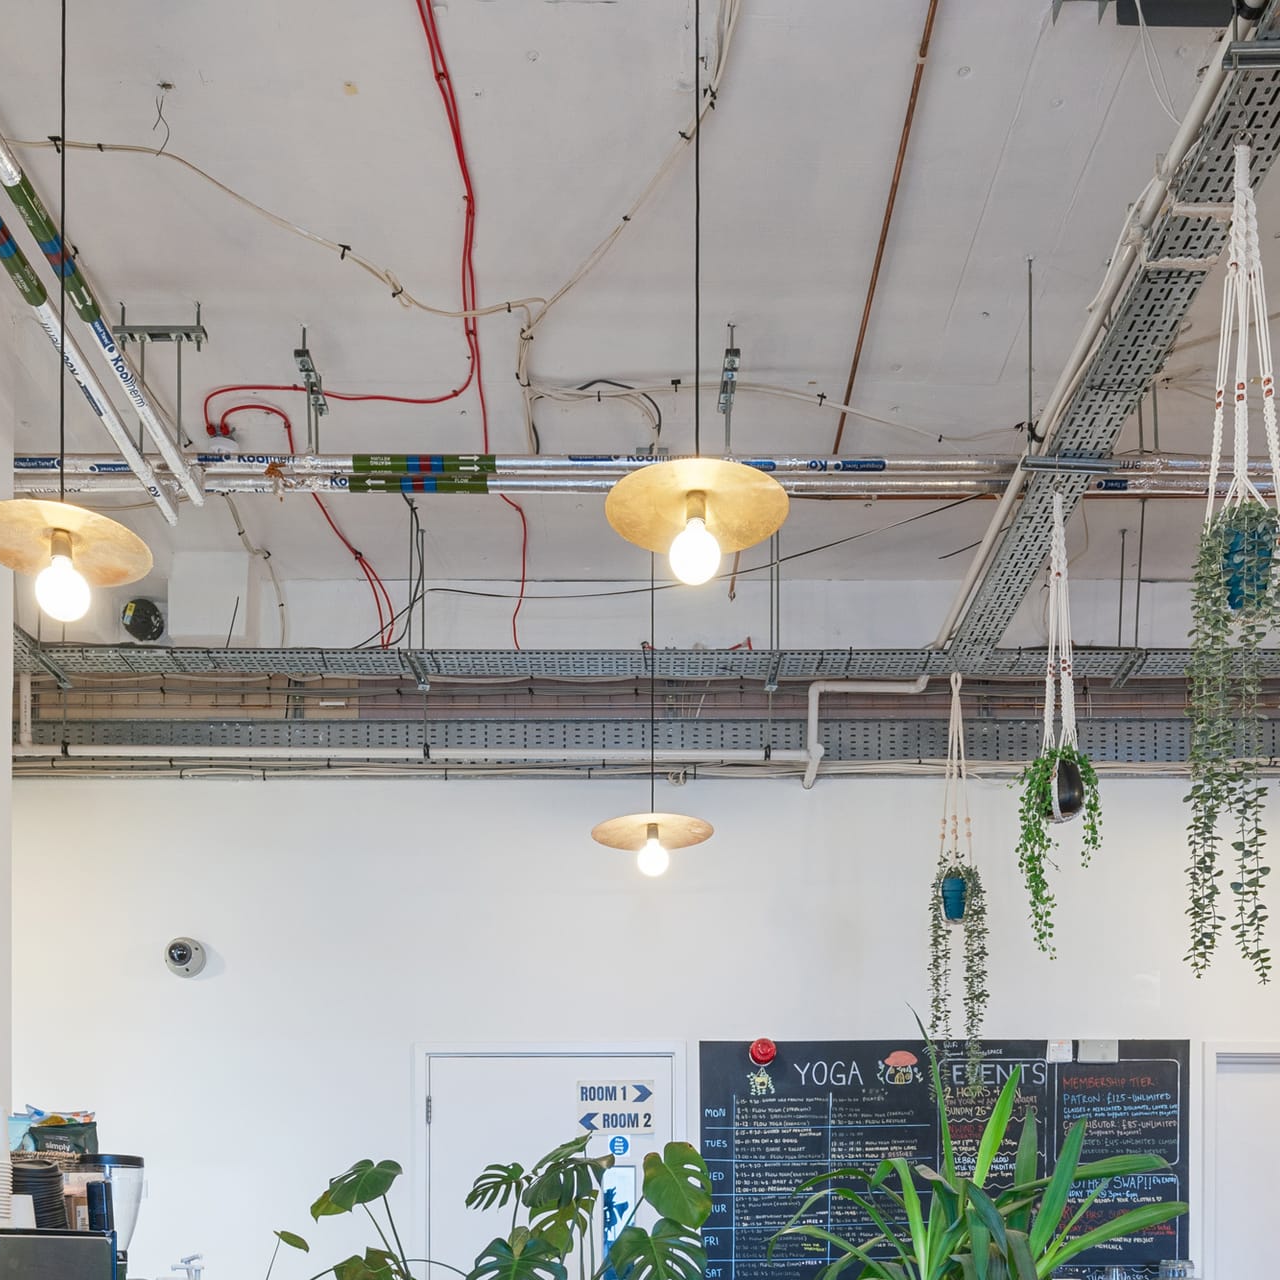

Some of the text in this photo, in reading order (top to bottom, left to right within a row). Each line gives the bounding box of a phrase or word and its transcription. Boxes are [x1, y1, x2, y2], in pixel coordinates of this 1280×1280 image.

[793, 1059, 865, 1087] YOGA
[1063, 1076, 1127, 1090] MEMBERSHIP
[579, 1085, 628, 1102] ROOM 1
[704, 1107, 727, 1118] MON
[602, 1112, 653, 1129] ROOM 2
[704, 1138, 728, 1149] TUES
[704, 1235, 720, 1247] FRI
[704, 1268, 723, 1279] SAT
